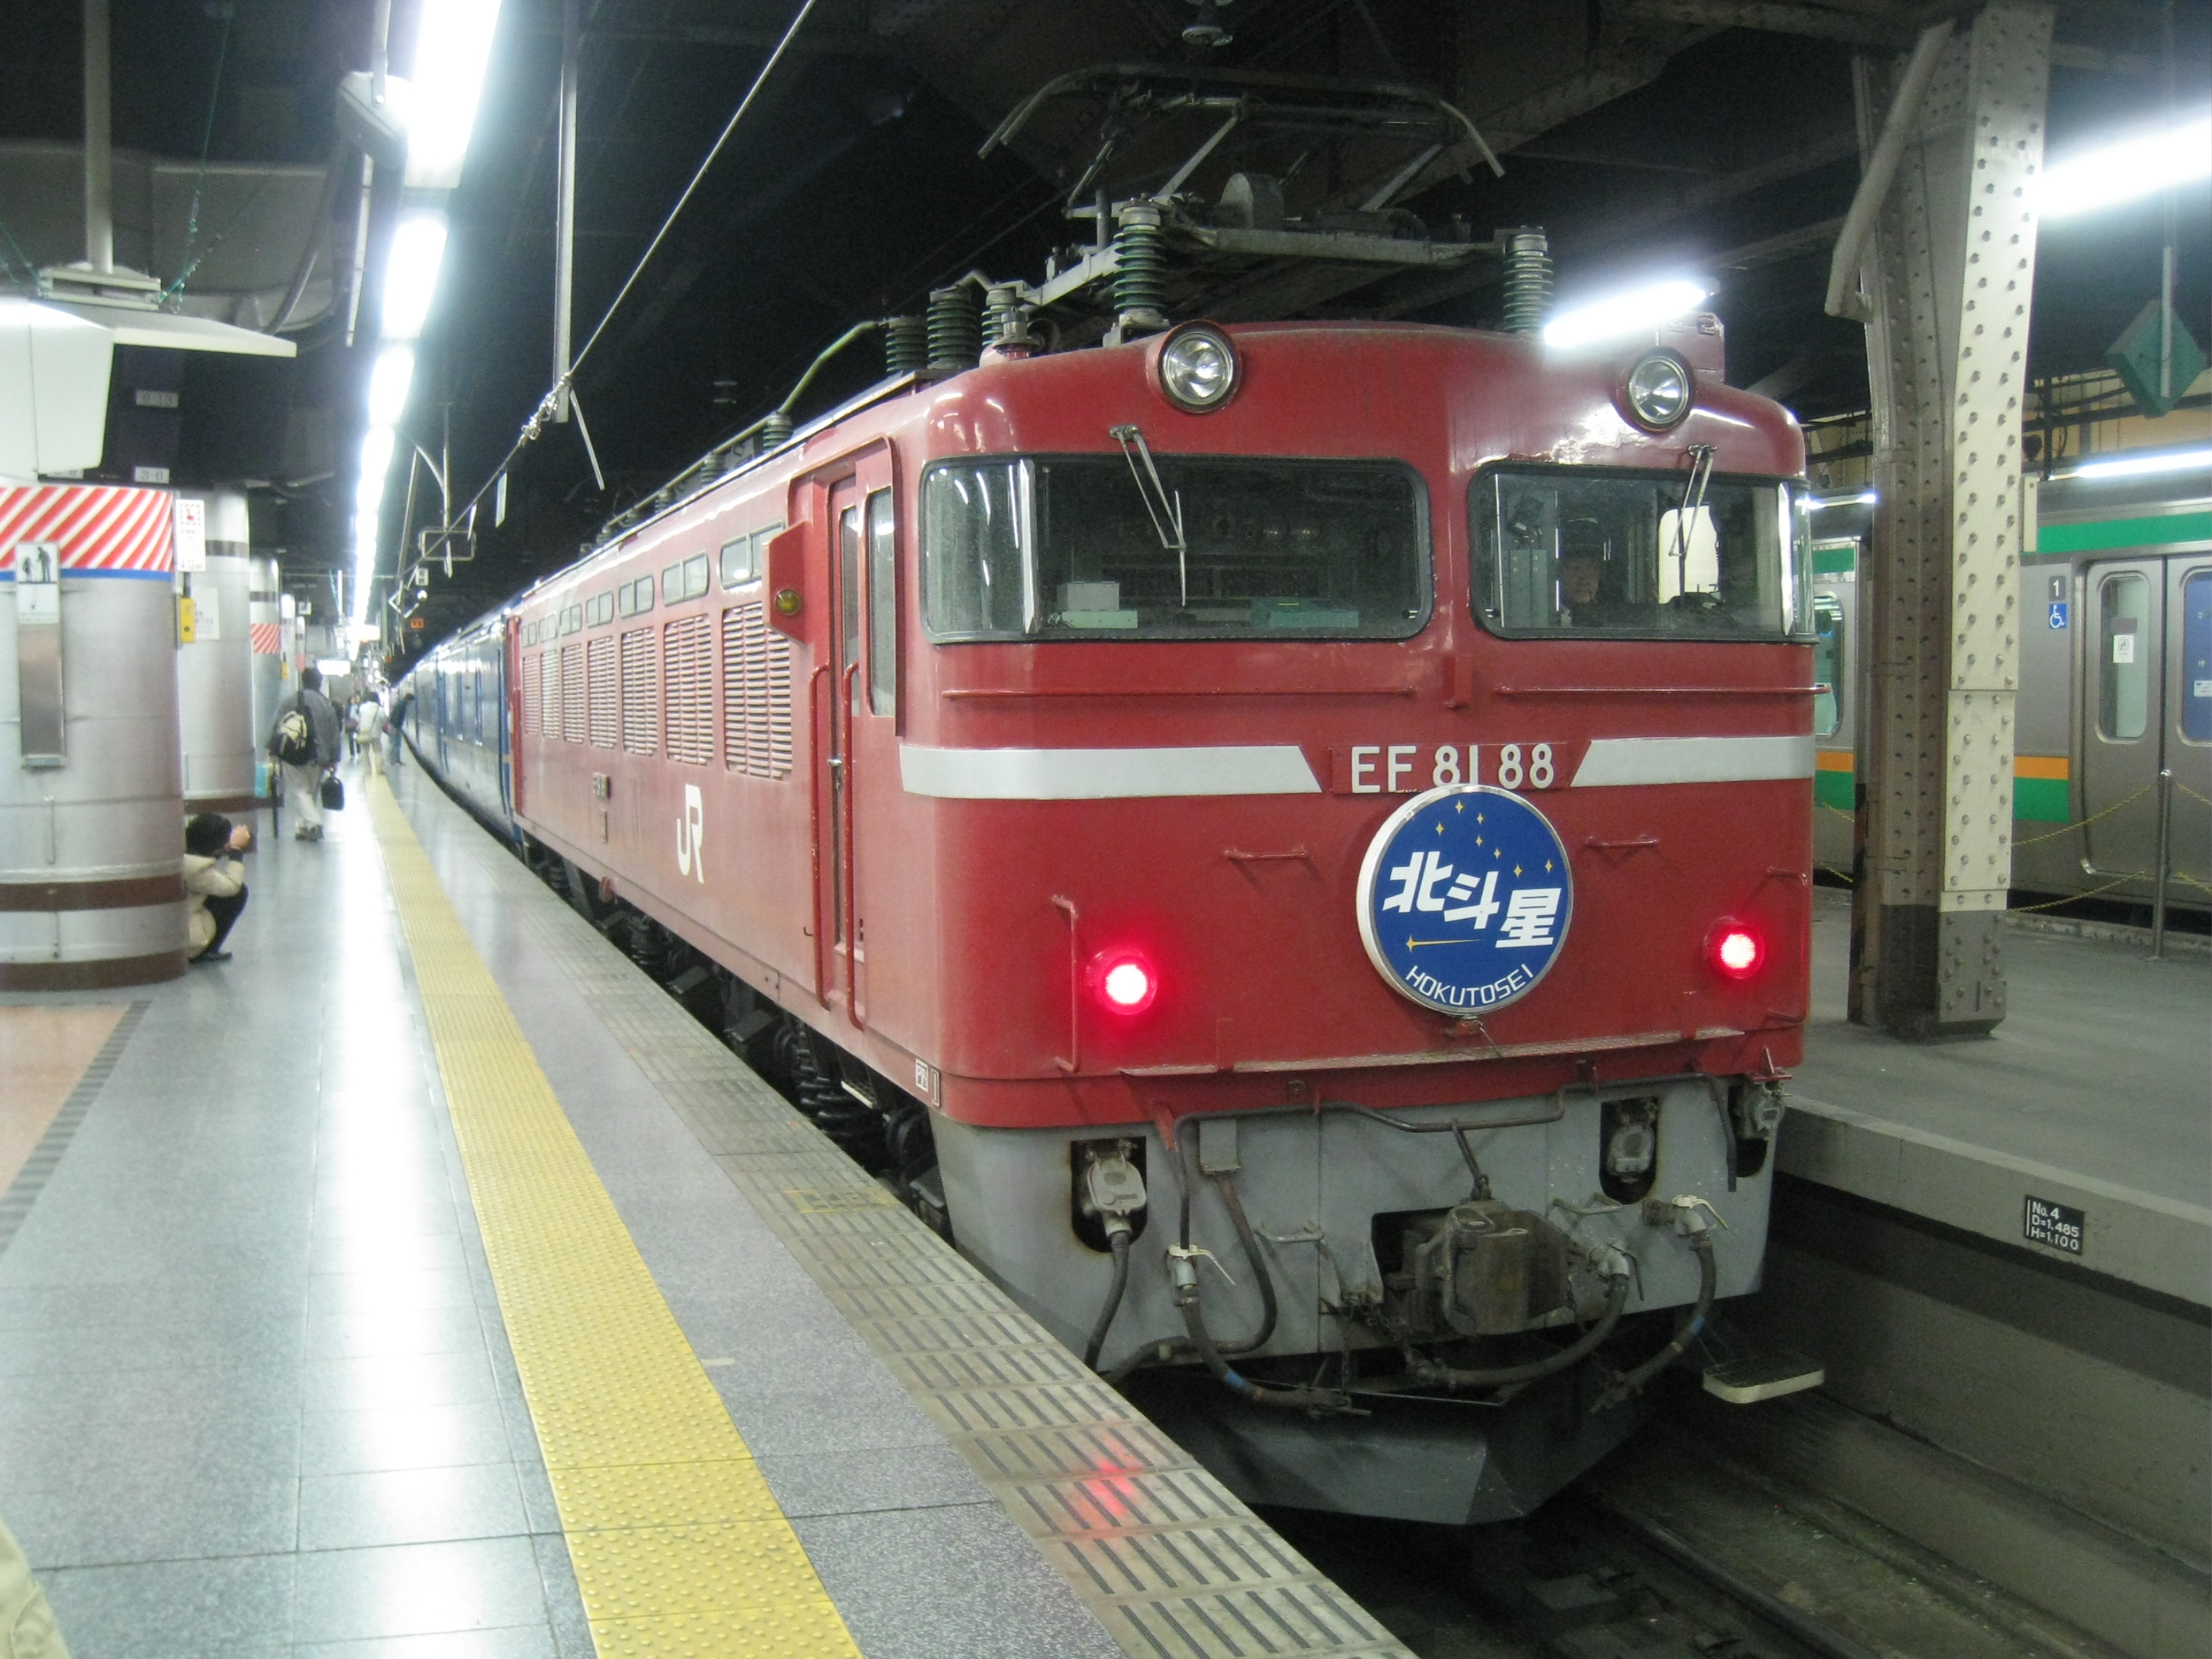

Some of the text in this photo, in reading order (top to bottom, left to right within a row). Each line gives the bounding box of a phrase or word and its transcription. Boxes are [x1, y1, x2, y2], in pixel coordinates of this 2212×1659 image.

[1351, 742, 1555, 794] EF 81 88
[676, 783, 705, 884] JR
[1382, 850, 1563, 949] 北斗星
[1405, 963, 1534, 1006] HOKUTOSEI
